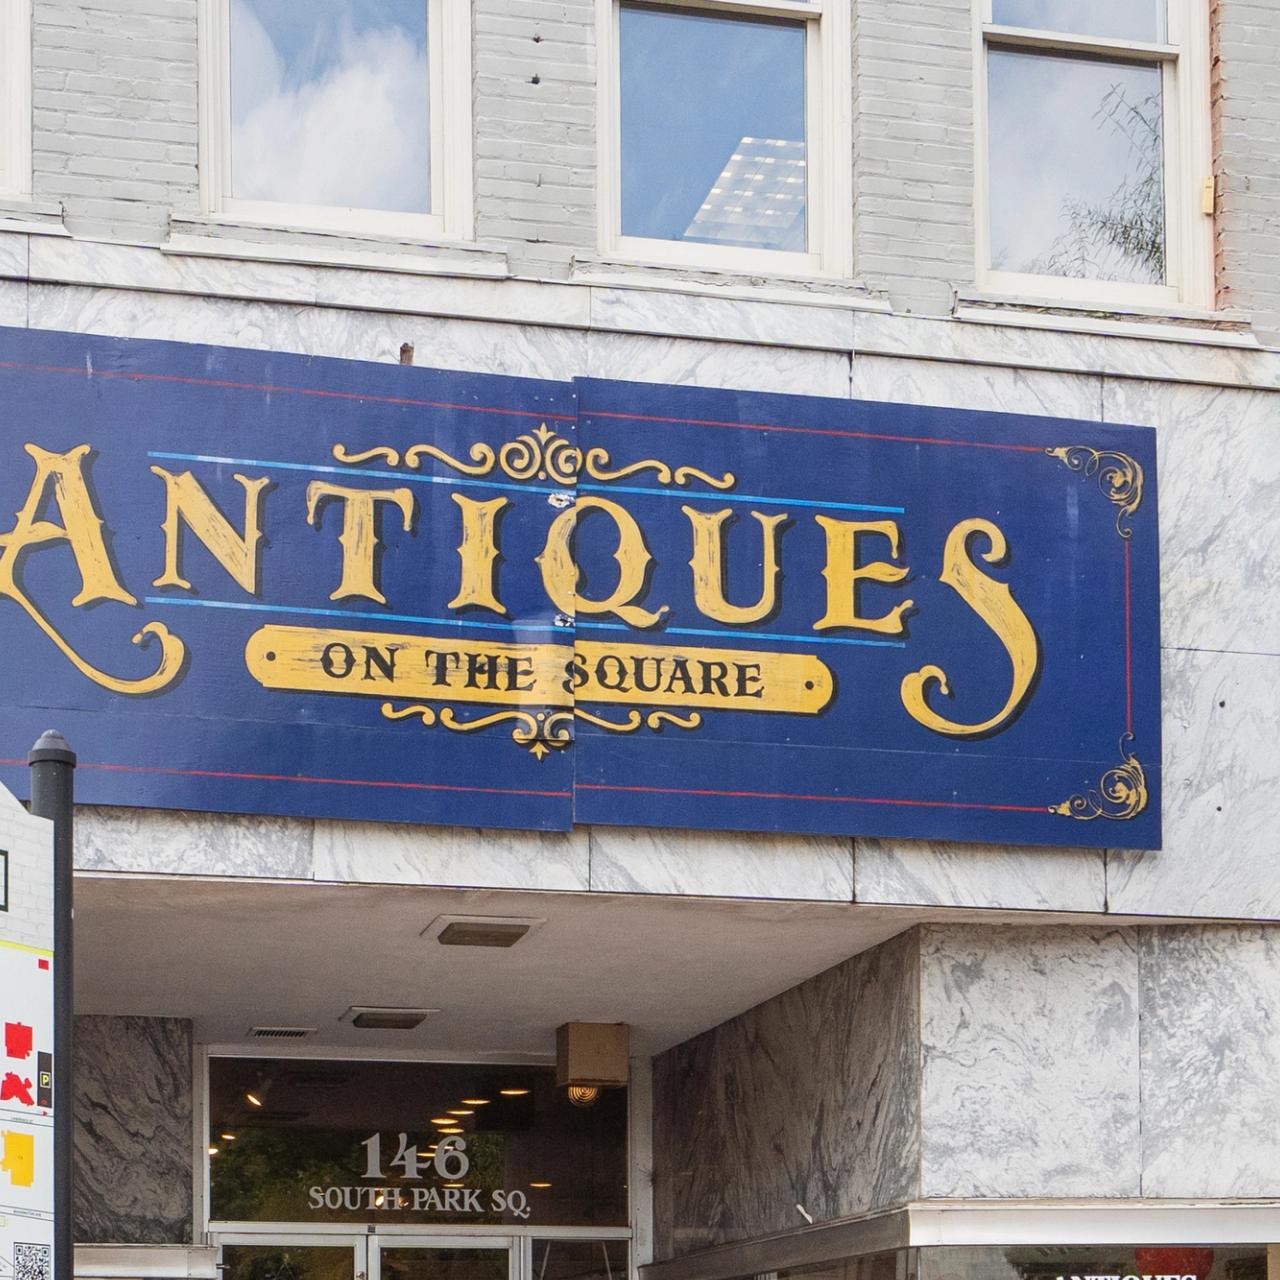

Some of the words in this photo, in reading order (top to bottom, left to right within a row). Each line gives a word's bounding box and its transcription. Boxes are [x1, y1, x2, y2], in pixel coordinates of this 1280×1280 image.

[321, 641, 397, 683] ON
[433, 648, 538, 693] THE
[563, 650, 766, 699] SQUARE
[360, 1131, 470, 1180] 146
[308, 1186, 402, 1211] SOUTH
[410, 1189, 484, 1213] PARK
[490, 1190, 531, 1219] SQ.
